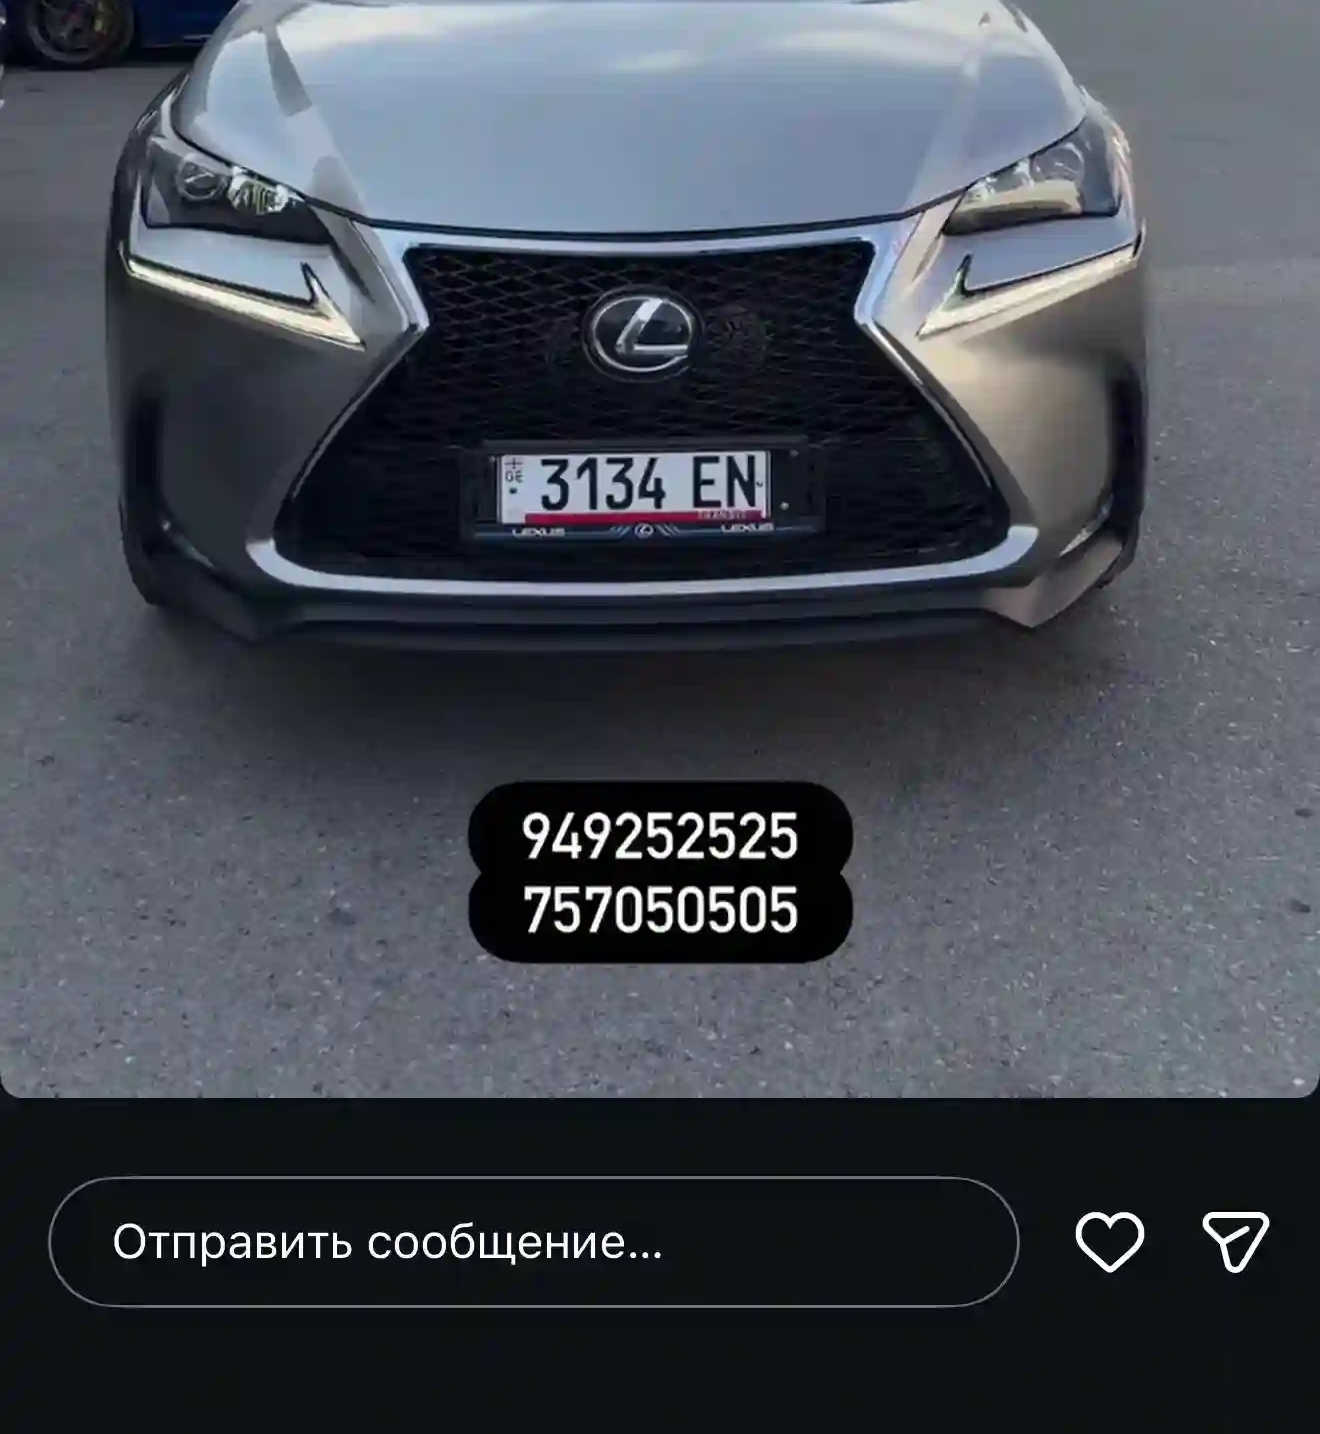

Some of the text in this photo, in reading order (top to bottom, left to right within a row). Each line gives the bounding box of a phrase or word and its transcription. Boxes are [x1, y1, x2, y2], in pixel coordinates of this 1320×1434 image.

[541, 455, 756, 511] 3134 EN
[512, 527, 566, 538] LEXUS
